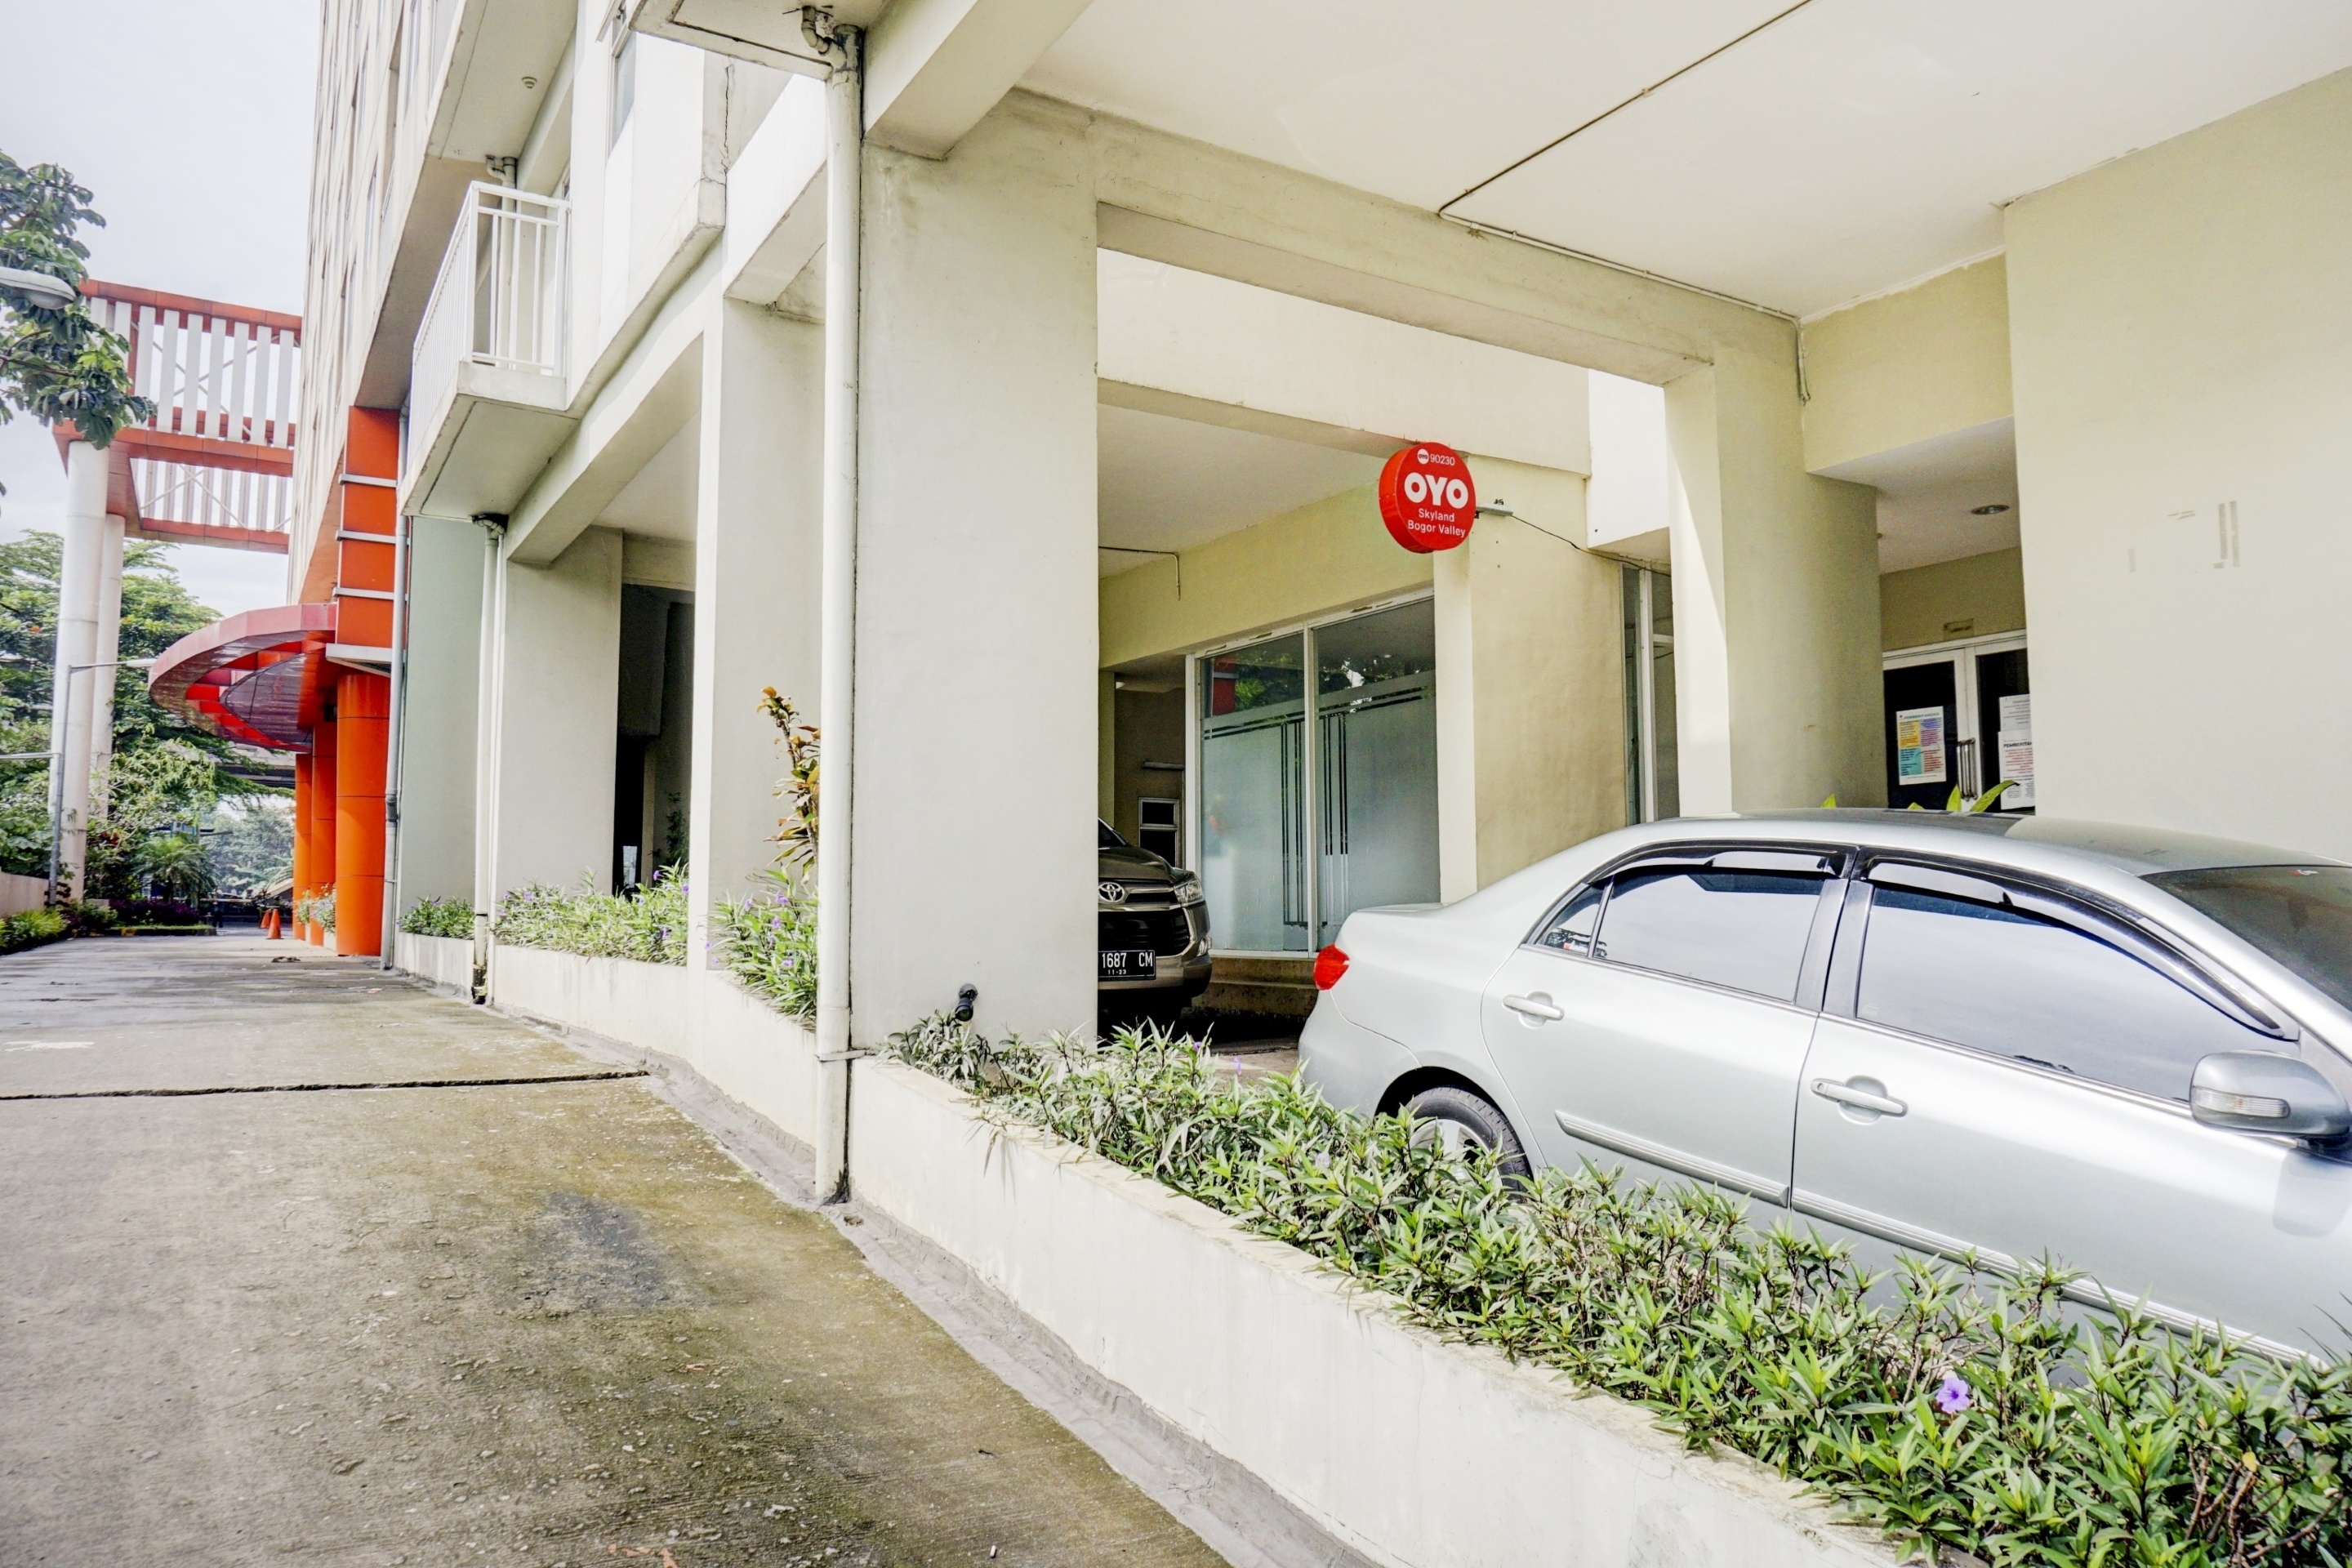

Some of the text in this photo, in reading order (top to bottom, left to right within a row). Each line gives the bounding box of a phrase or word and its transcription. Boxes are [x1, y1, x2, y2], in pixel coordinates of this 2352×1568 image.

[1430, 454, 1455, 466] 90230
[1404, 472, 1469, 510] OYO
[1419, 508, 1454, 522] Skyland
[1408, 519, 1466, 538] Bogor Valley
[1102, 952, 1152, 969] 1687 CM
